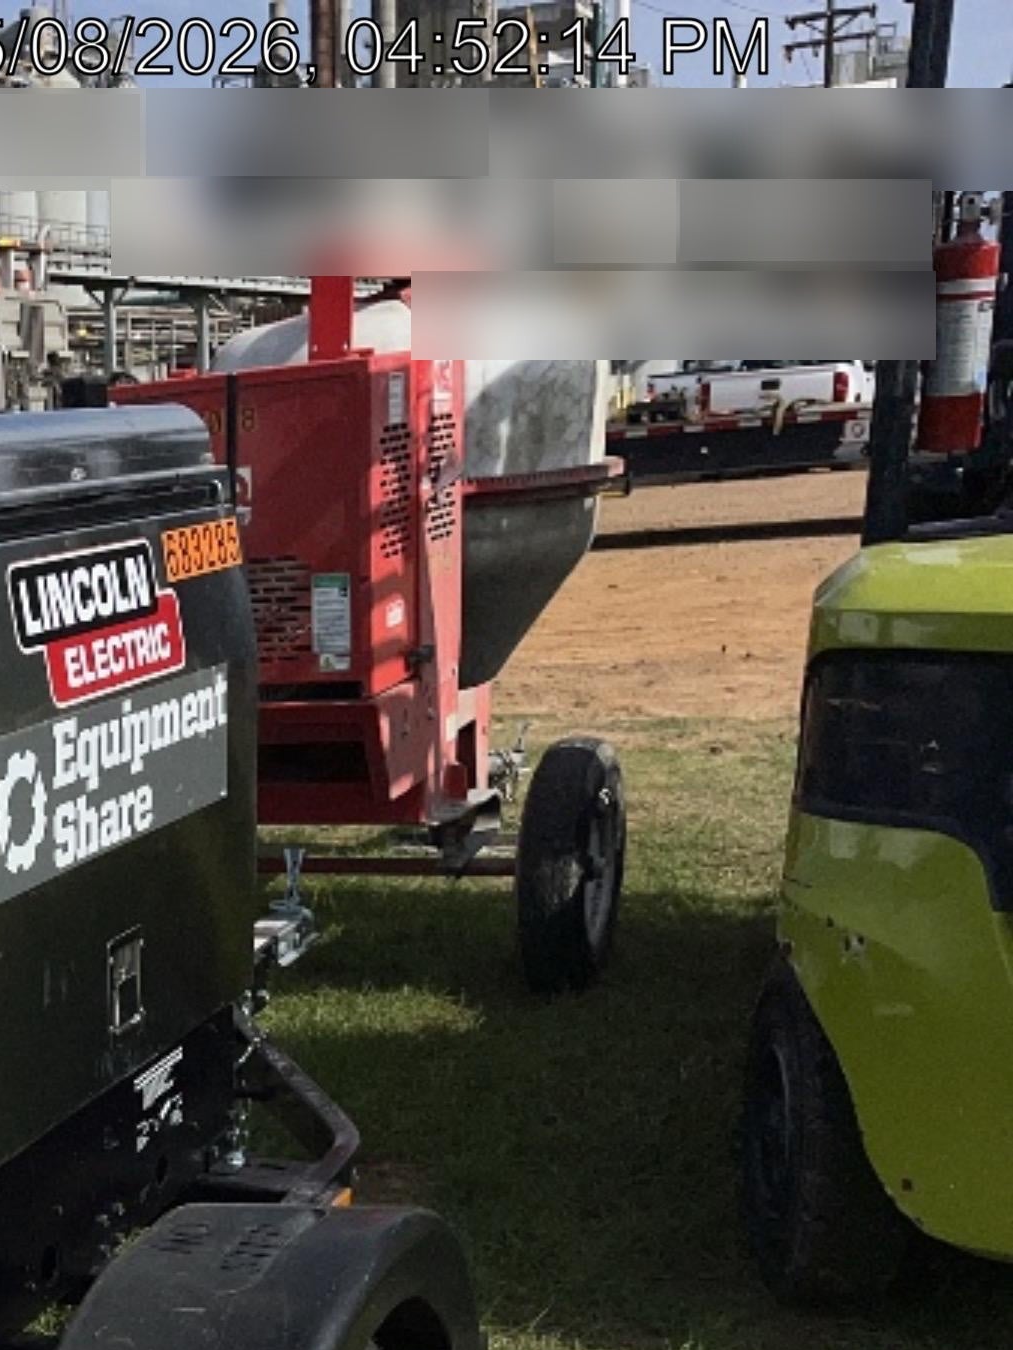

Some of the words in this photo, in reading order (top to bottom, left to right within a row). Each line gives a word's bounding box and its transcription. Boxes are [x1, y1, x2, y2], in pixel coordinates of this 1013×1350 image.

[166, 521, 238, 577] 683285
[18, 554, 151, 637] LINCOLN
[63, 622, 171, 689] ELECTRIC
[52, 673, 228, 791] Equipment
[52, 785, 154, 869] Share
